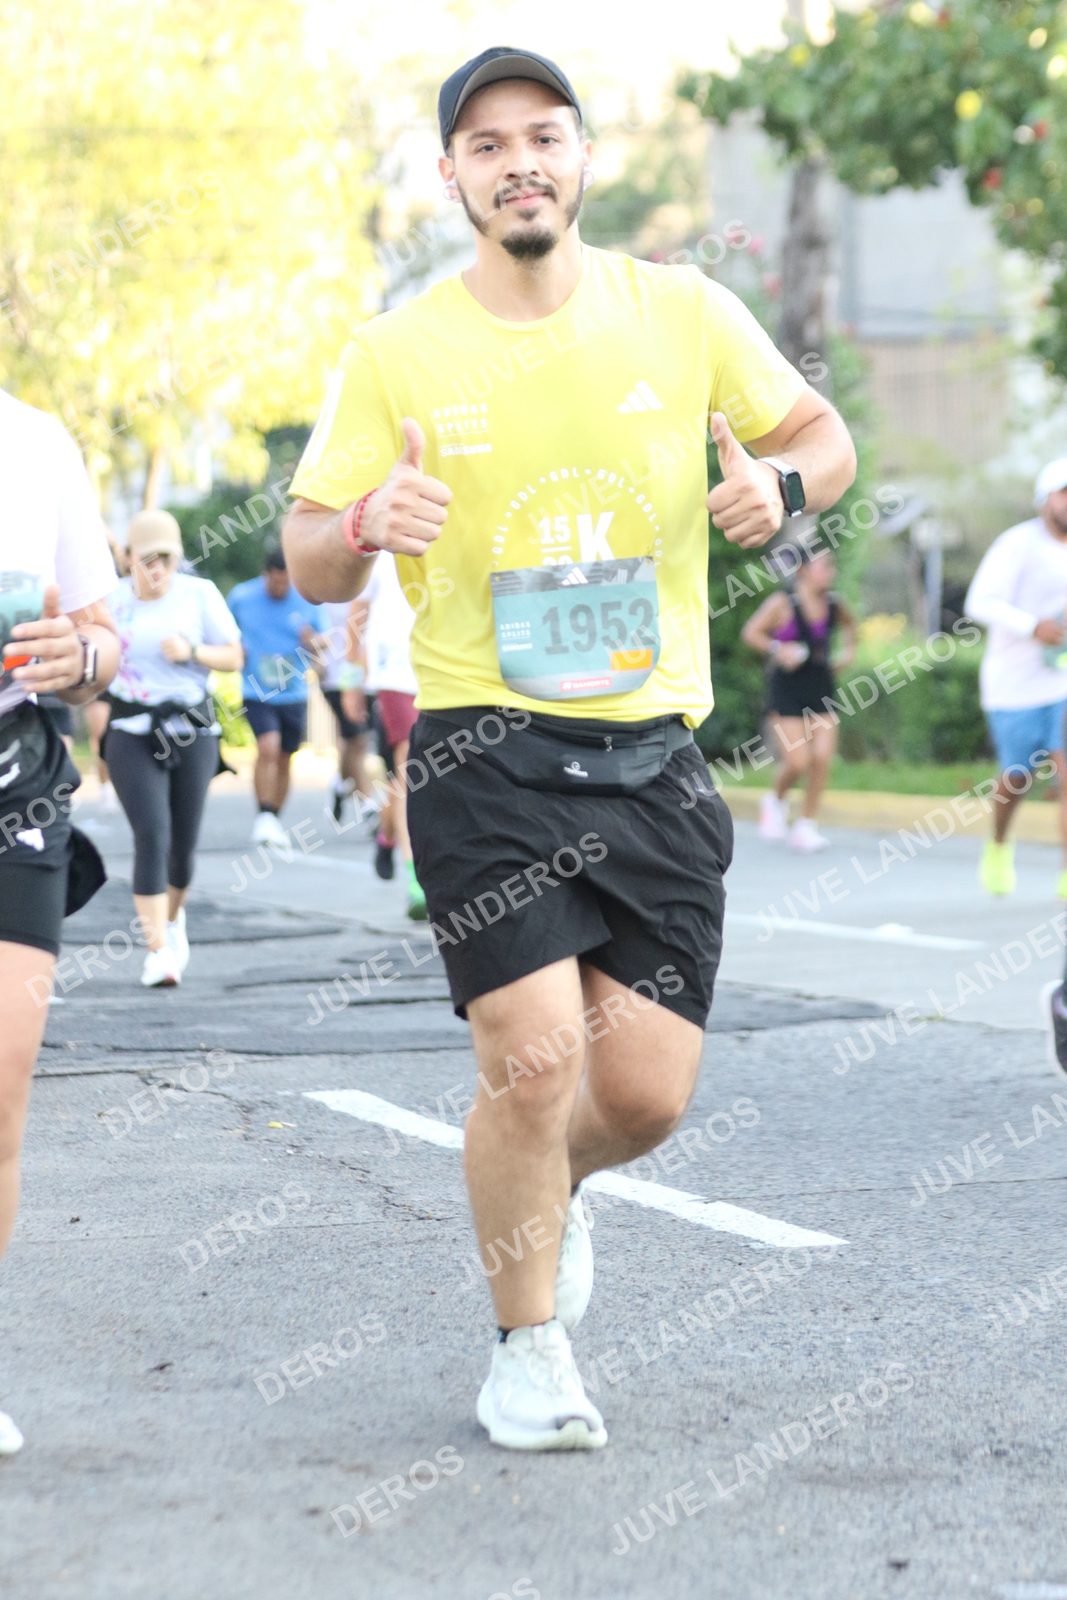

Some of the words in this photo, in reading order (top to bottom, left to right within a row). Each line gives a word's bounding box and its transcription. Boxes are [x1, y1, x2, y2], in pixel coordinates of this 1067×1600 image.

[538, 515, 572, 545] 15
[576, 511, 615, 564] K
[541, 597, 657, 656] 1952
